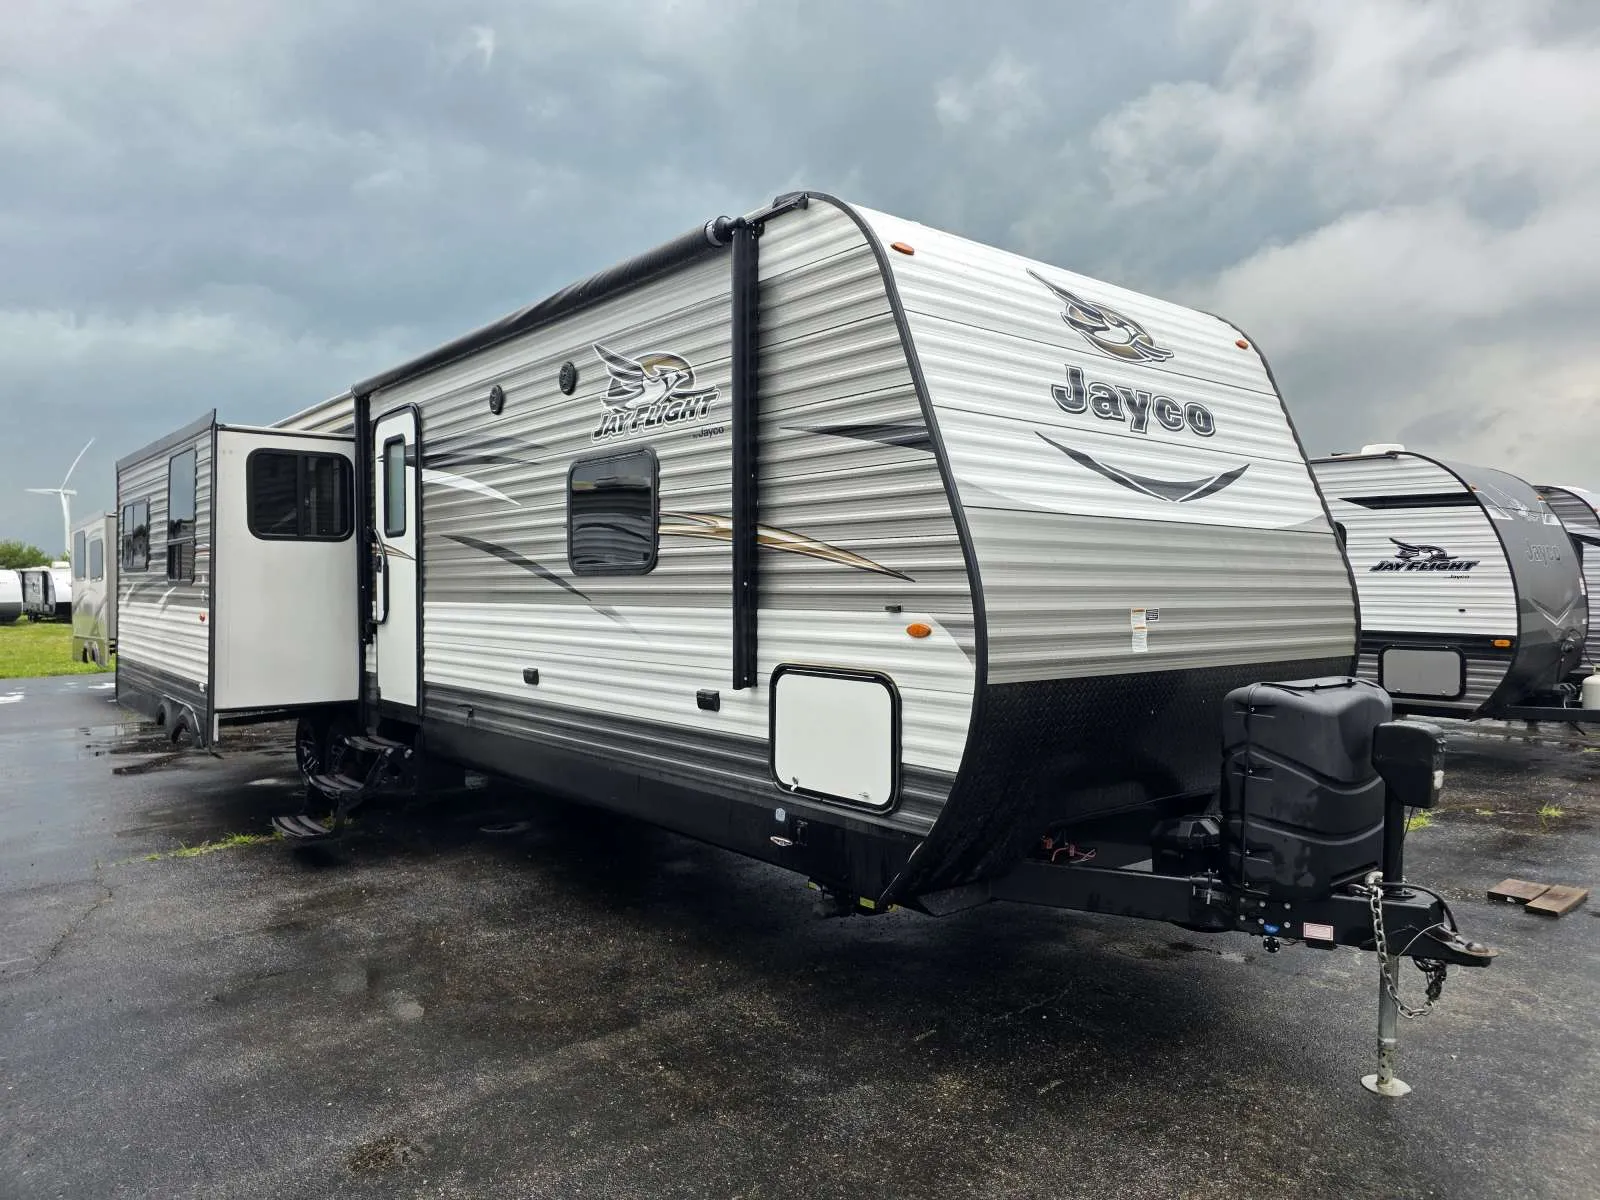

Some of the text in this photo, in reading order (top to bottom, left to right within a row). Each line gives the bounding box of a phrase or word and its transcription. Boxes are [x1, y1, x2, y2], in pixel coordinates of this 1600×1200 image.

[592, 391, 720, 440] JAY FLIGHT
[1051, 364, 1216, 437] Jayco
[698, 426, 724, 438] Jayco
[1369, 560, 1480, 572] JAY FLIGHT
